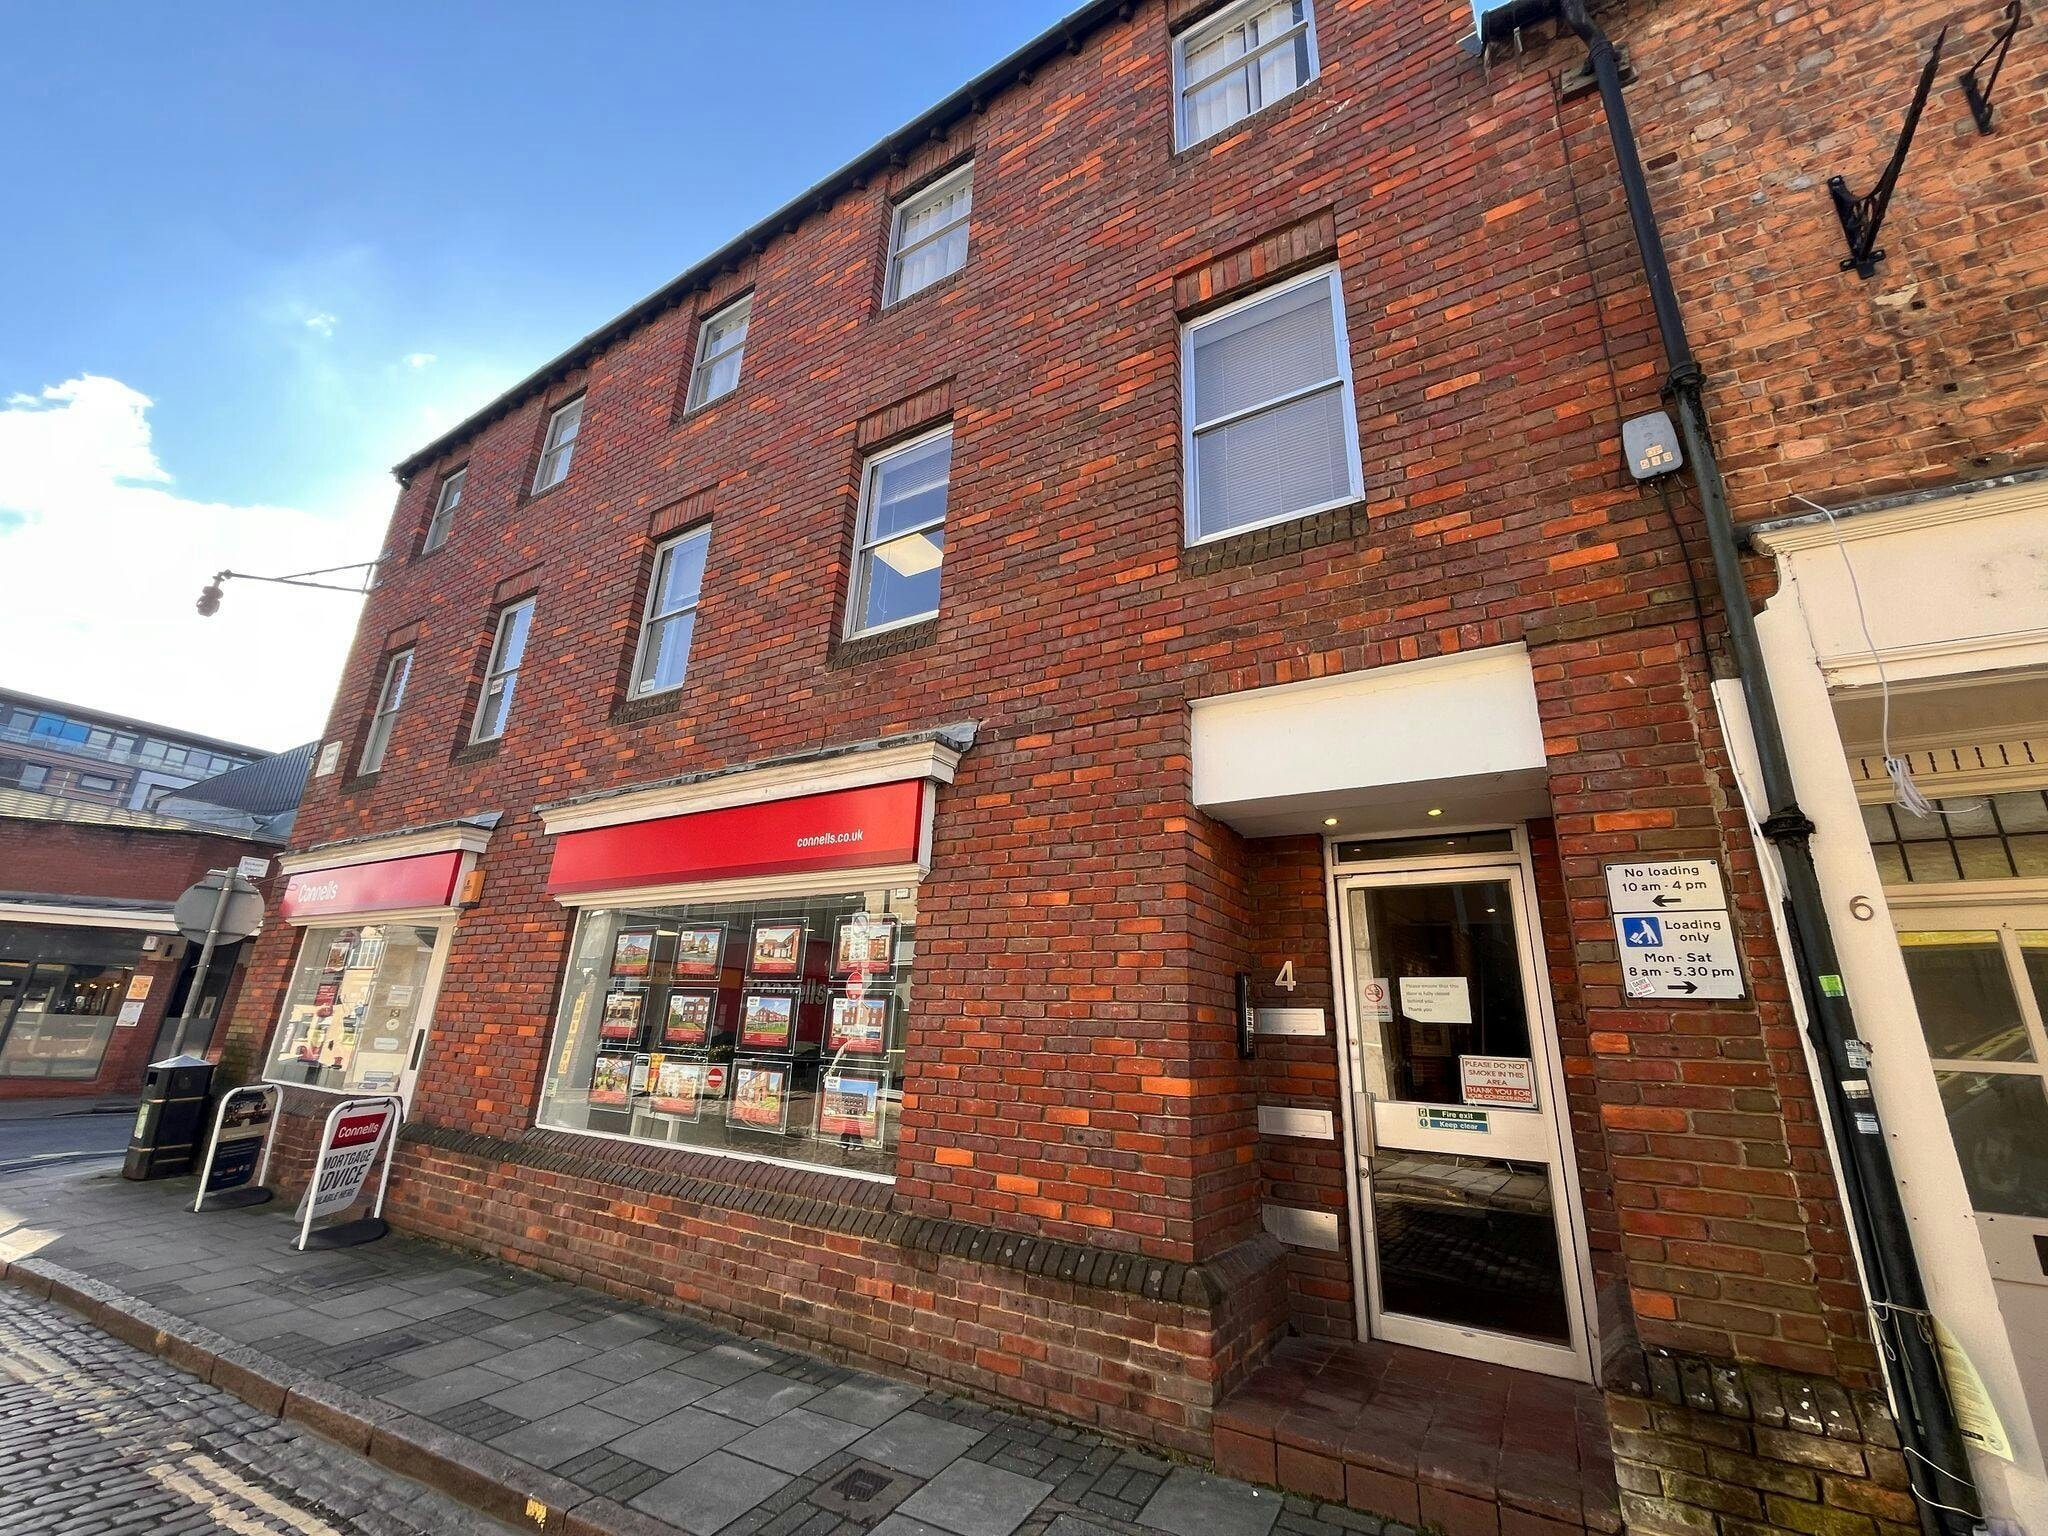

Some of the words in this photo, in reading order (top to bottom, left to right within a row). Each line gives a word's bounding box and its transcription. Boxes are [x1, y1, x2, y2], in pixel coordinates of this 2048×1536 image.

[797, 829, 863, 847] connells.co.uk
[1624, 868, 1643, 877] No
[1649, 866, 1700, 877] loading
[298, 880, 338, 903] Connells
[1622, 883, 1638, 892] 10
[1641, 883, 1661, 891] am
[1672, 881, 1681, 890] 4
[1686, 881, 1707, 891] pm
[1849, 895, 1874, 921] 6
[1665, 920, 1721, 930] Loading
[1679, 933, 1710, 943] only
[1644, 953, 1675, 962] Mon
[1686, 952, 1712, 962] Sat
[1275, 961, 1296, 991] 4
[1629, 967, 1638, 976] 8
[1641, 968, 1662, 976] am
[1673, 967, 1708, 977] 5.30
[1712, 968, 1734, 978] pm
[1468, 1069, 1496, 1077] SMOKE
[338, 1122, 379, 1138] Connells
[1440, 1121, 1458, 1130] Keep
[323, 1148, 374, 1170] MORTGAGE
